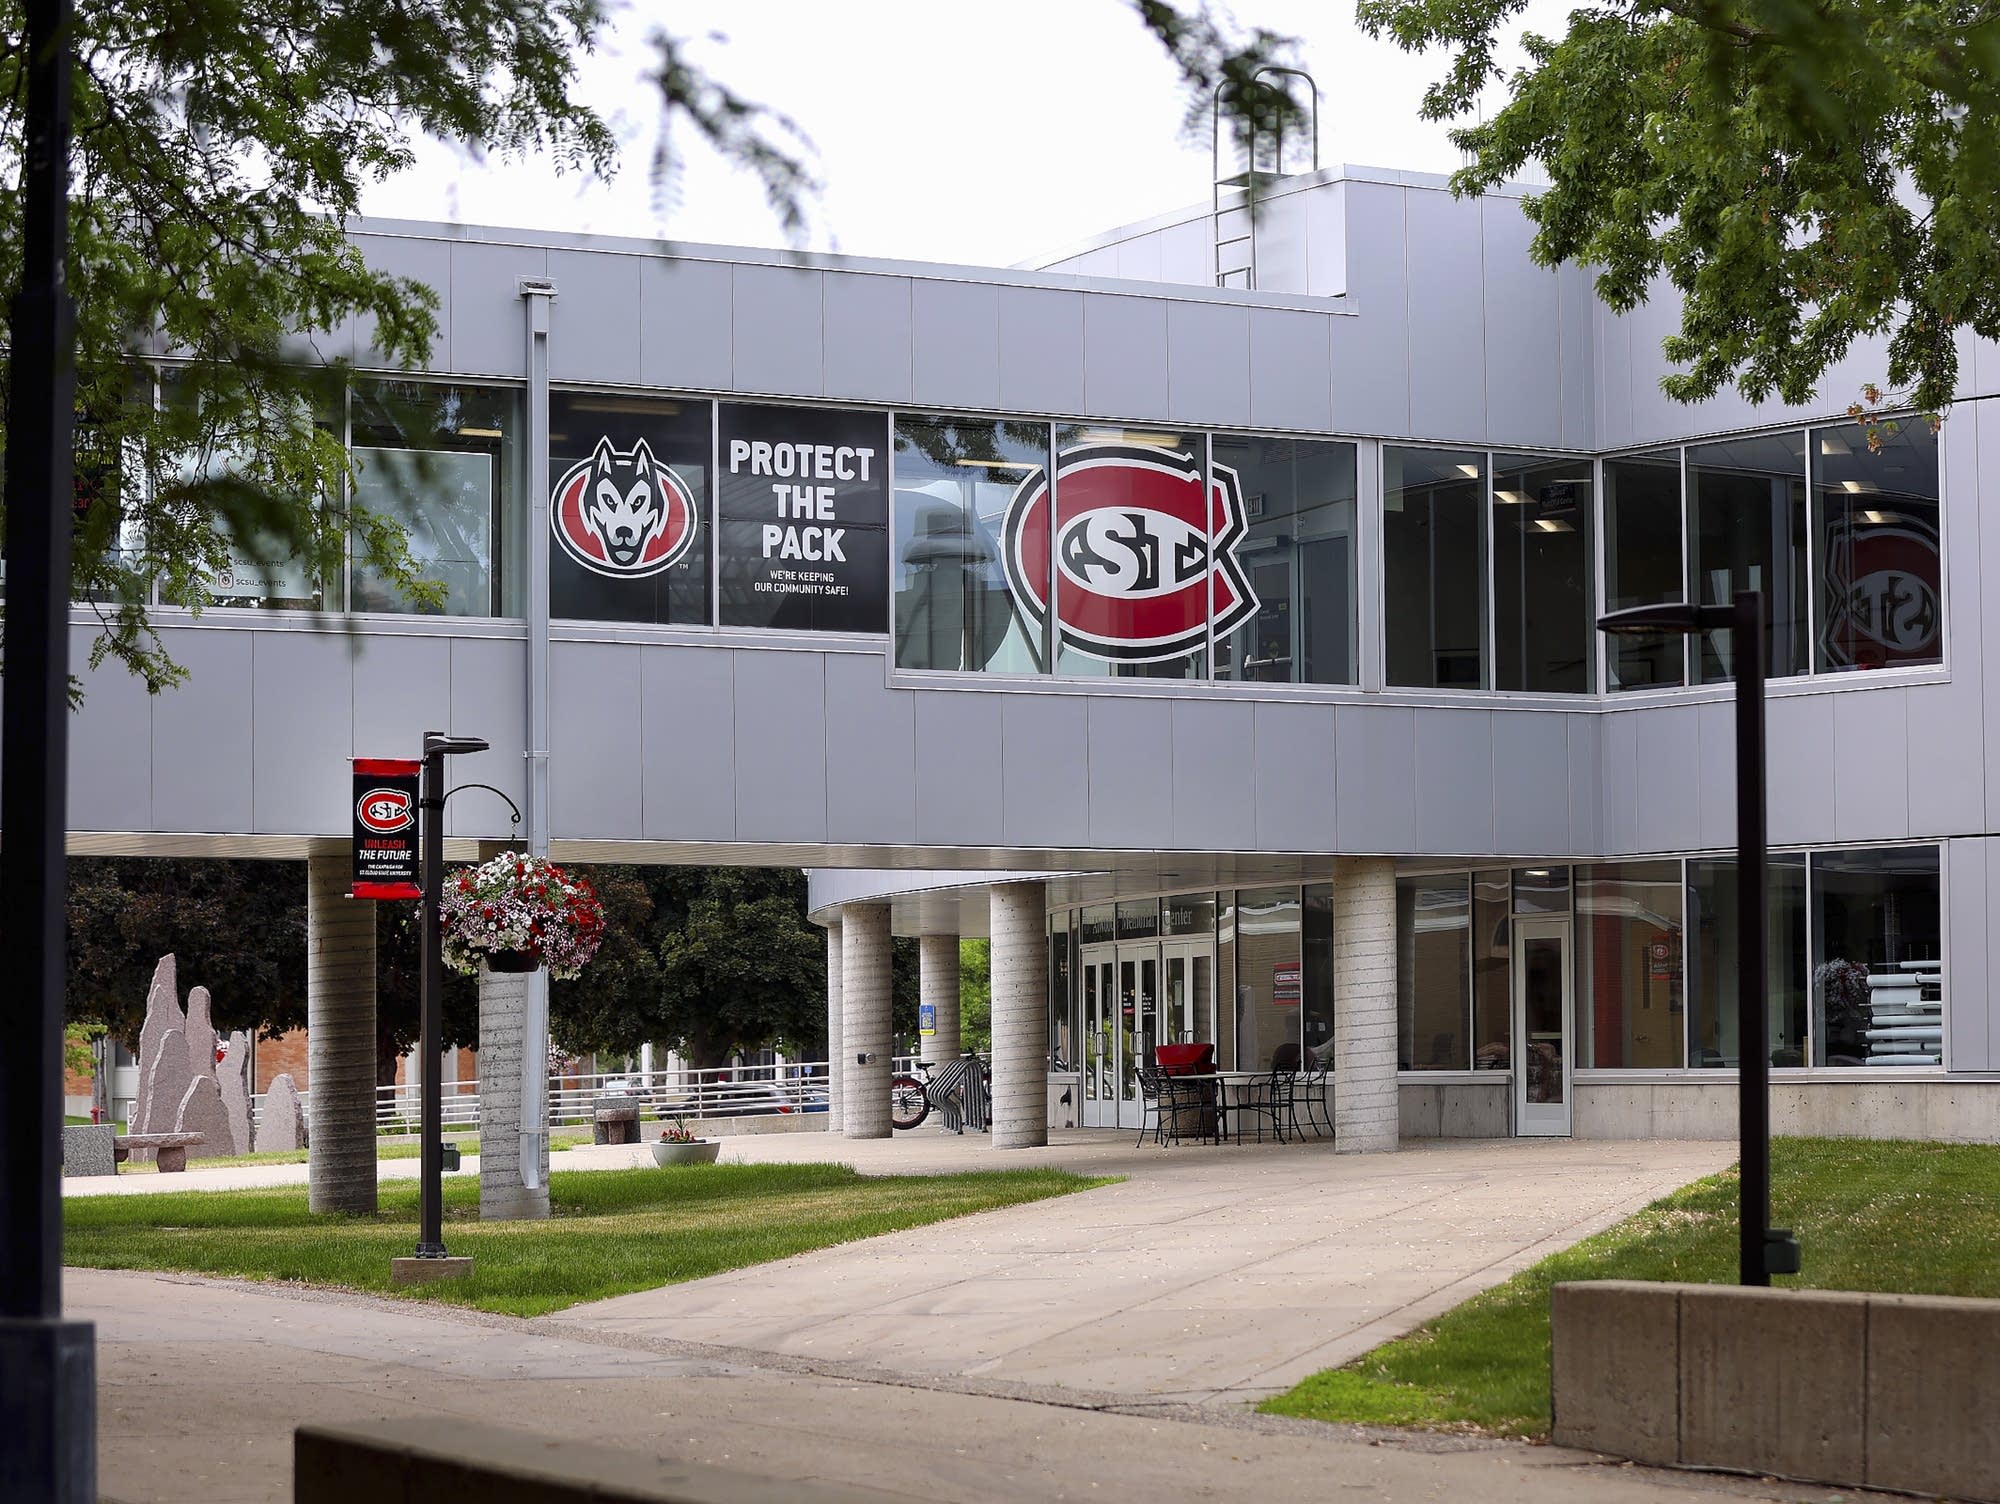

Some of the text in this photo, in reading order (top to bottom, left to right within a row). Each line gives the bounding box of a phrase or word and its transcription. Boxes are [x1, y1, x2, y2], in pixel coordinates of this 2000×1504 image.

[730, 439, 875, 482] PROTECT
[772, 483, 836, 521] THE
[762, 524, 847, 562] PACK
[233, 558, 285, 568] scsu_events
[235, 578, 287, 588] scsu_events
[770, 570, 835, 583] WE'RE KEEPING
[754, 582, 849, 596] OUR COMMUNITY SAFE!
[364, 838, 406, 849] UNLEASH
[359, 849, 413, 860] THE FUTURE
